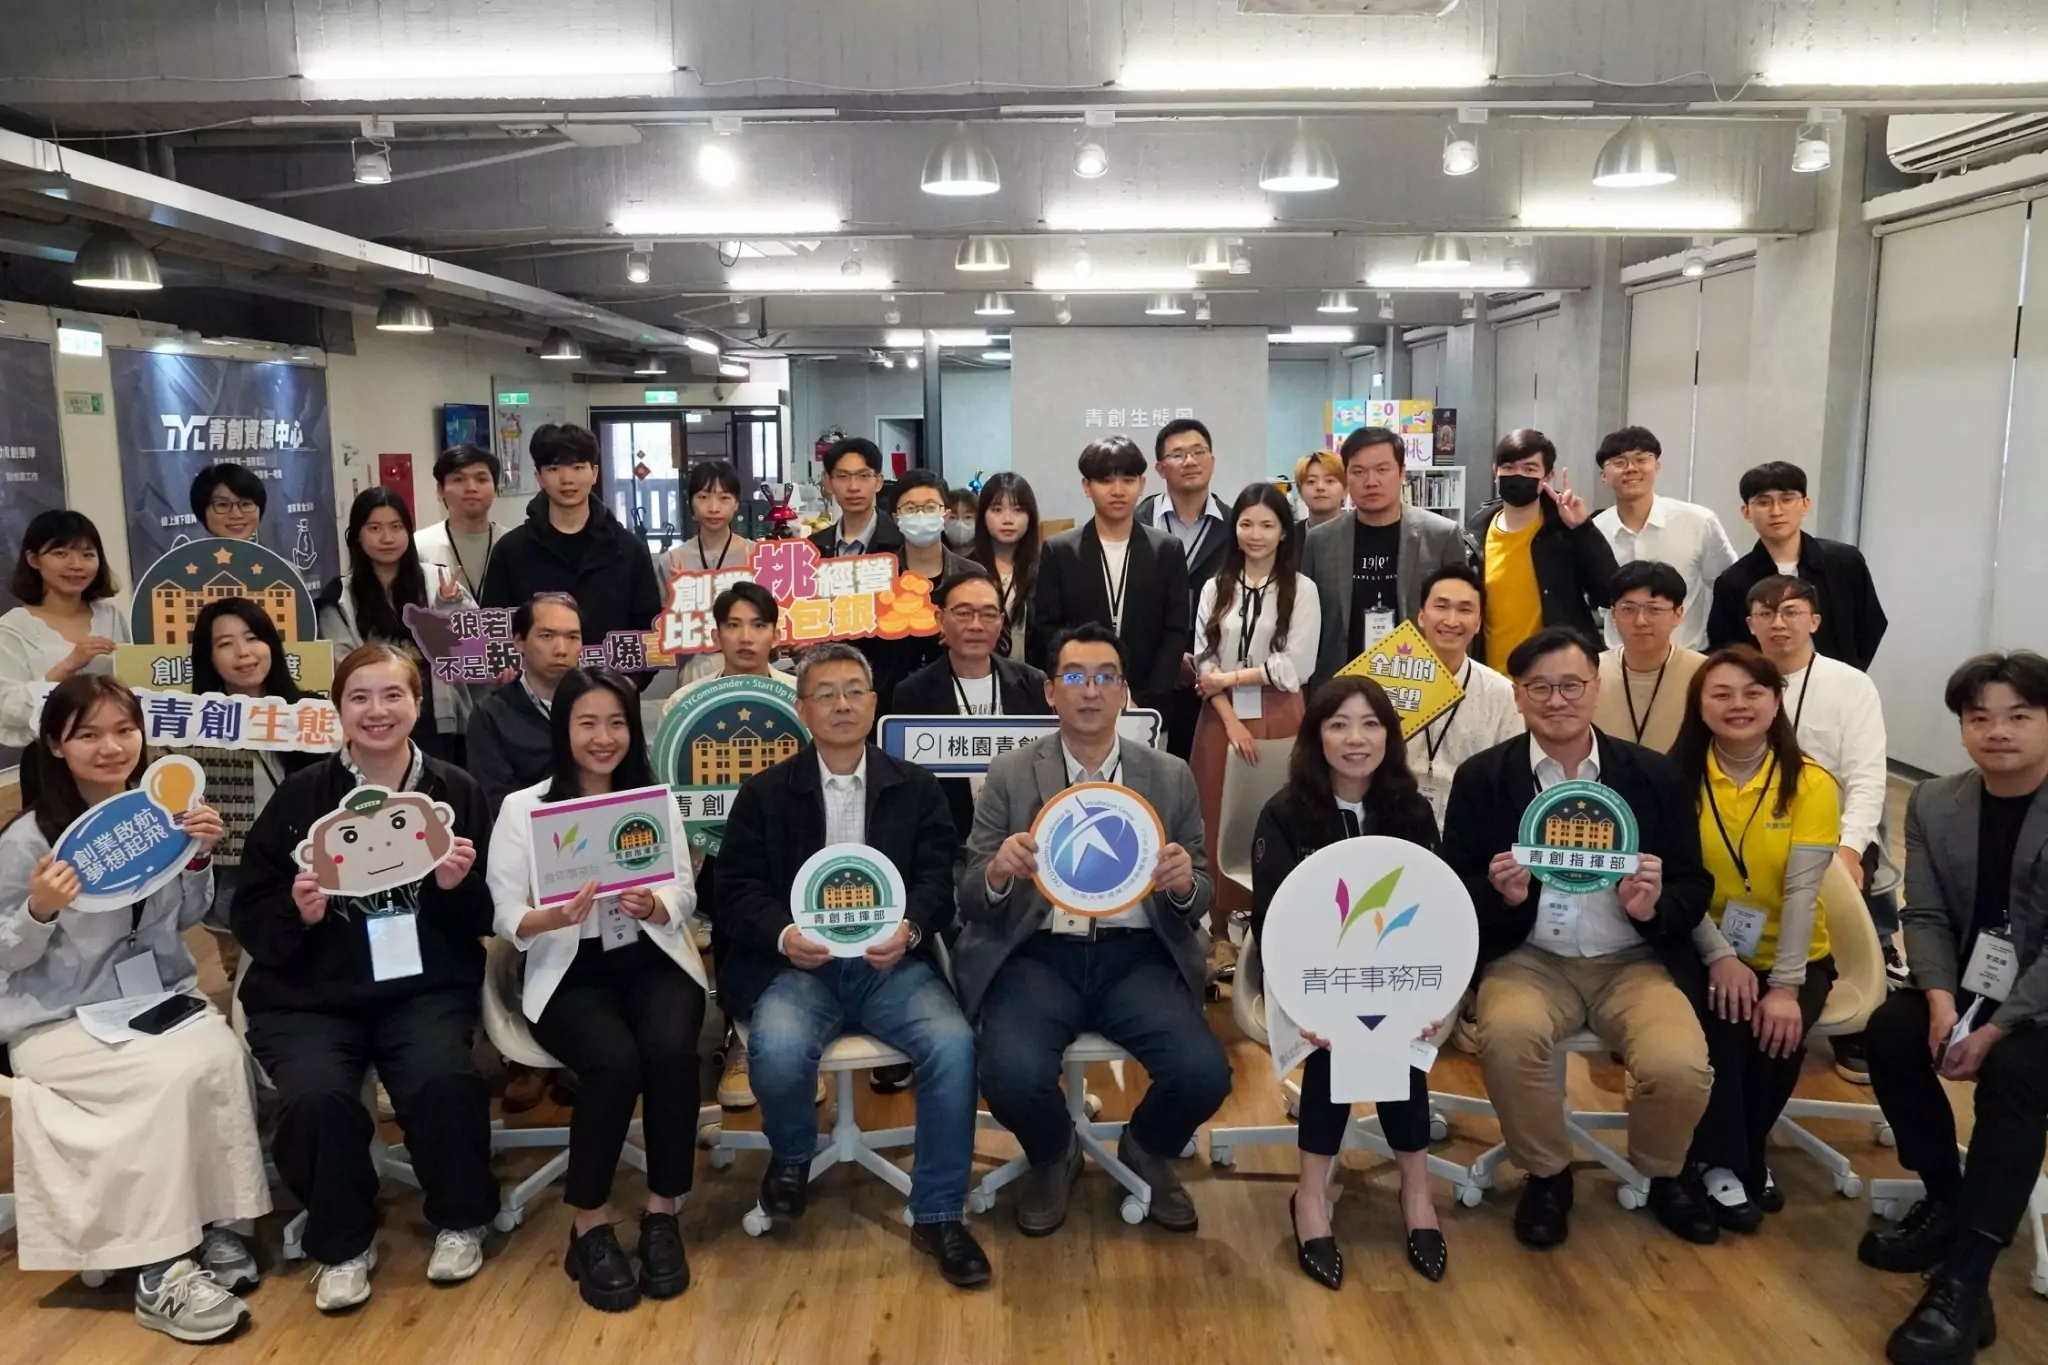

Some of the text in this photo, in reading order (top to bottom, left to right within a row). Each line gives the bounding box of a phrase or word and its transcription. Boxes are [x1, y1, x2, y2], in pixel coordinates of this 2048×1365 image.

[208, 418, 304, 450] 青創資源中心
[451, 610, 514, 641] 狼若
[1367, 652, 1437, 683] 全村的
[681, 678, 744, 710] TYCommander
[753, 679, 774, 692] Start
[775, 682, 787, 697] Up
[82, 823, 169, 885] 夢想起飛
[1529, 850, 1626, 870] 青創指揮部
[814, 909, 885, 925] 青創指揮部
[1301, 965, 1442, 995] 青年事務局
[159, 1296, 186, 1319] N
